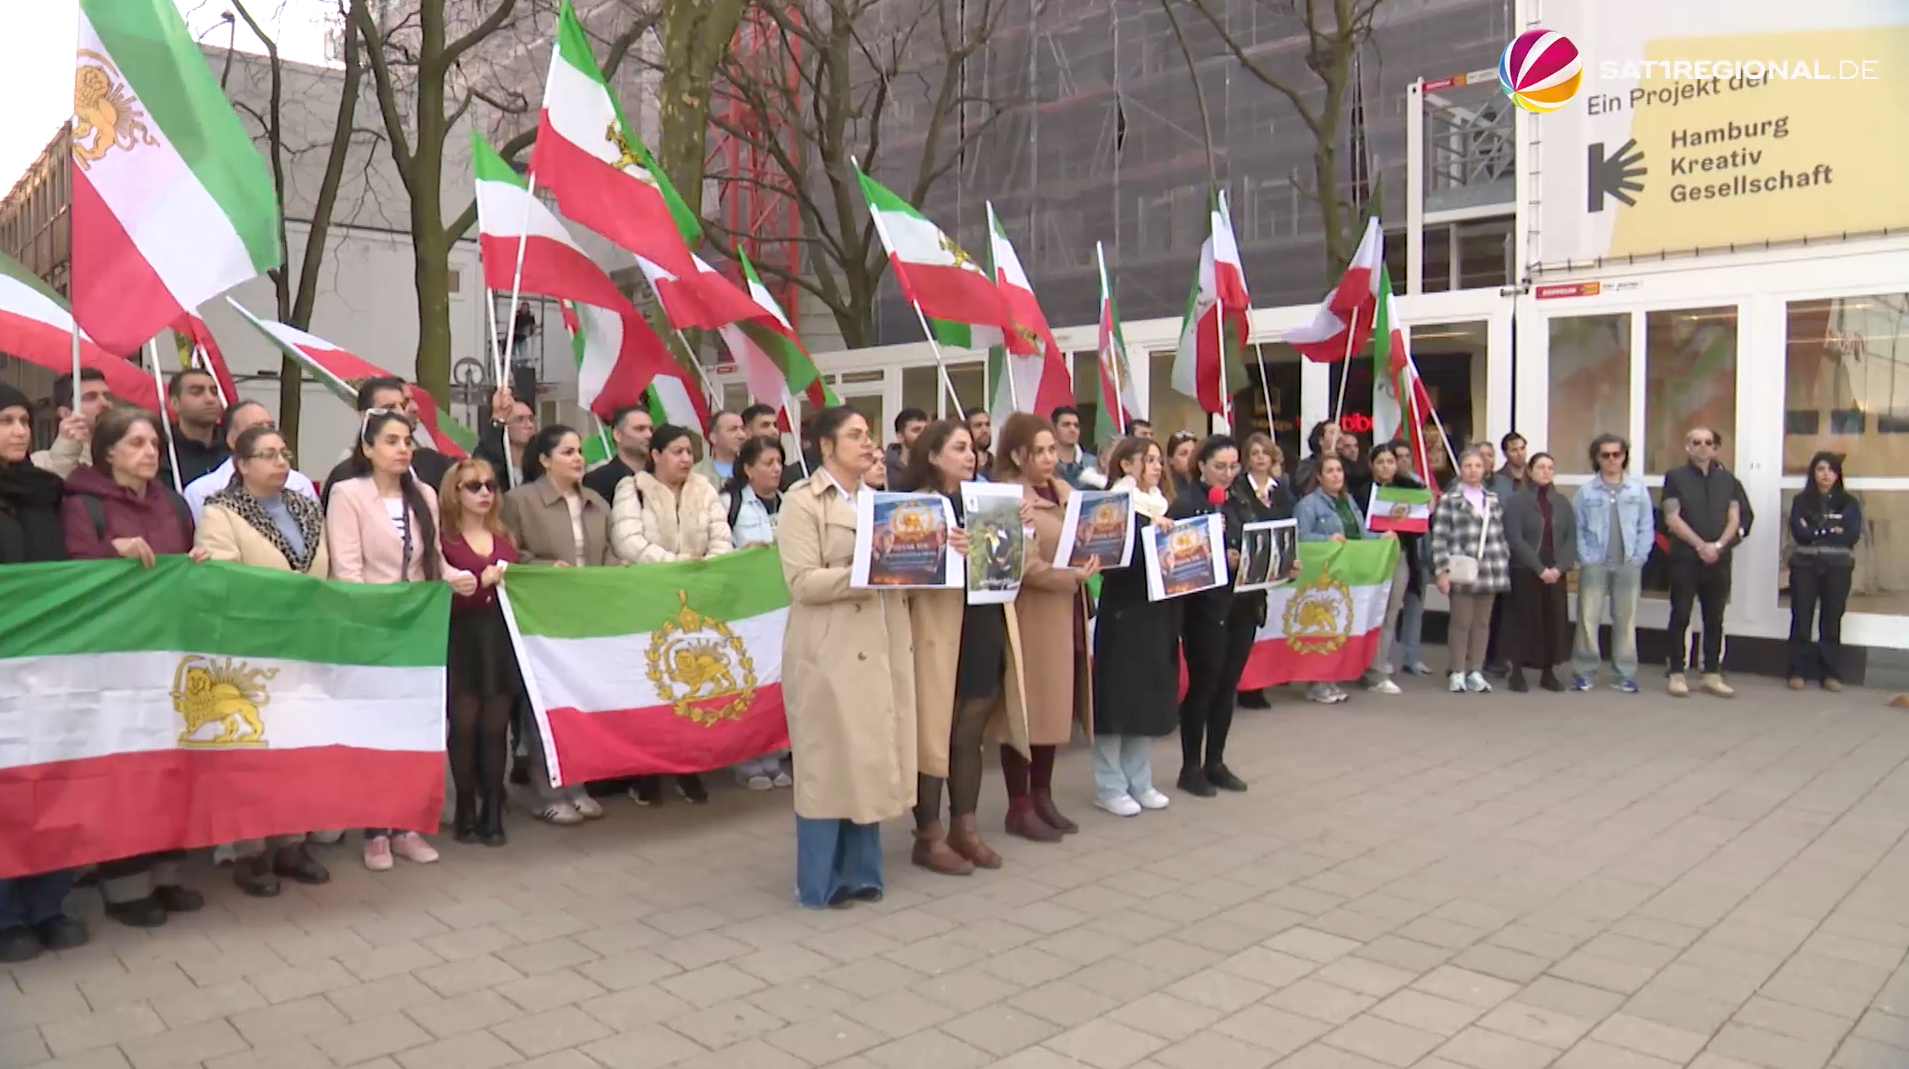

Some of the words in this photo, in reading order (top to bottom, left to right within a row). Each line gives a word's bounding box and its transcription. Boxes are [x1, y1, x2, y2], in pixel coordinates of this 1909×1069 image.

[1587, 94, 1622, 116] Ein
[1630, 75, 1721, 108] Projekt
[1728, 67, 1772, 91] der
[1670, 115, 1789, 149] Hamburg
[1670, 149, 1763, 176] Kreativ
[1669, 163, 1834, 203] Gesellschaft
